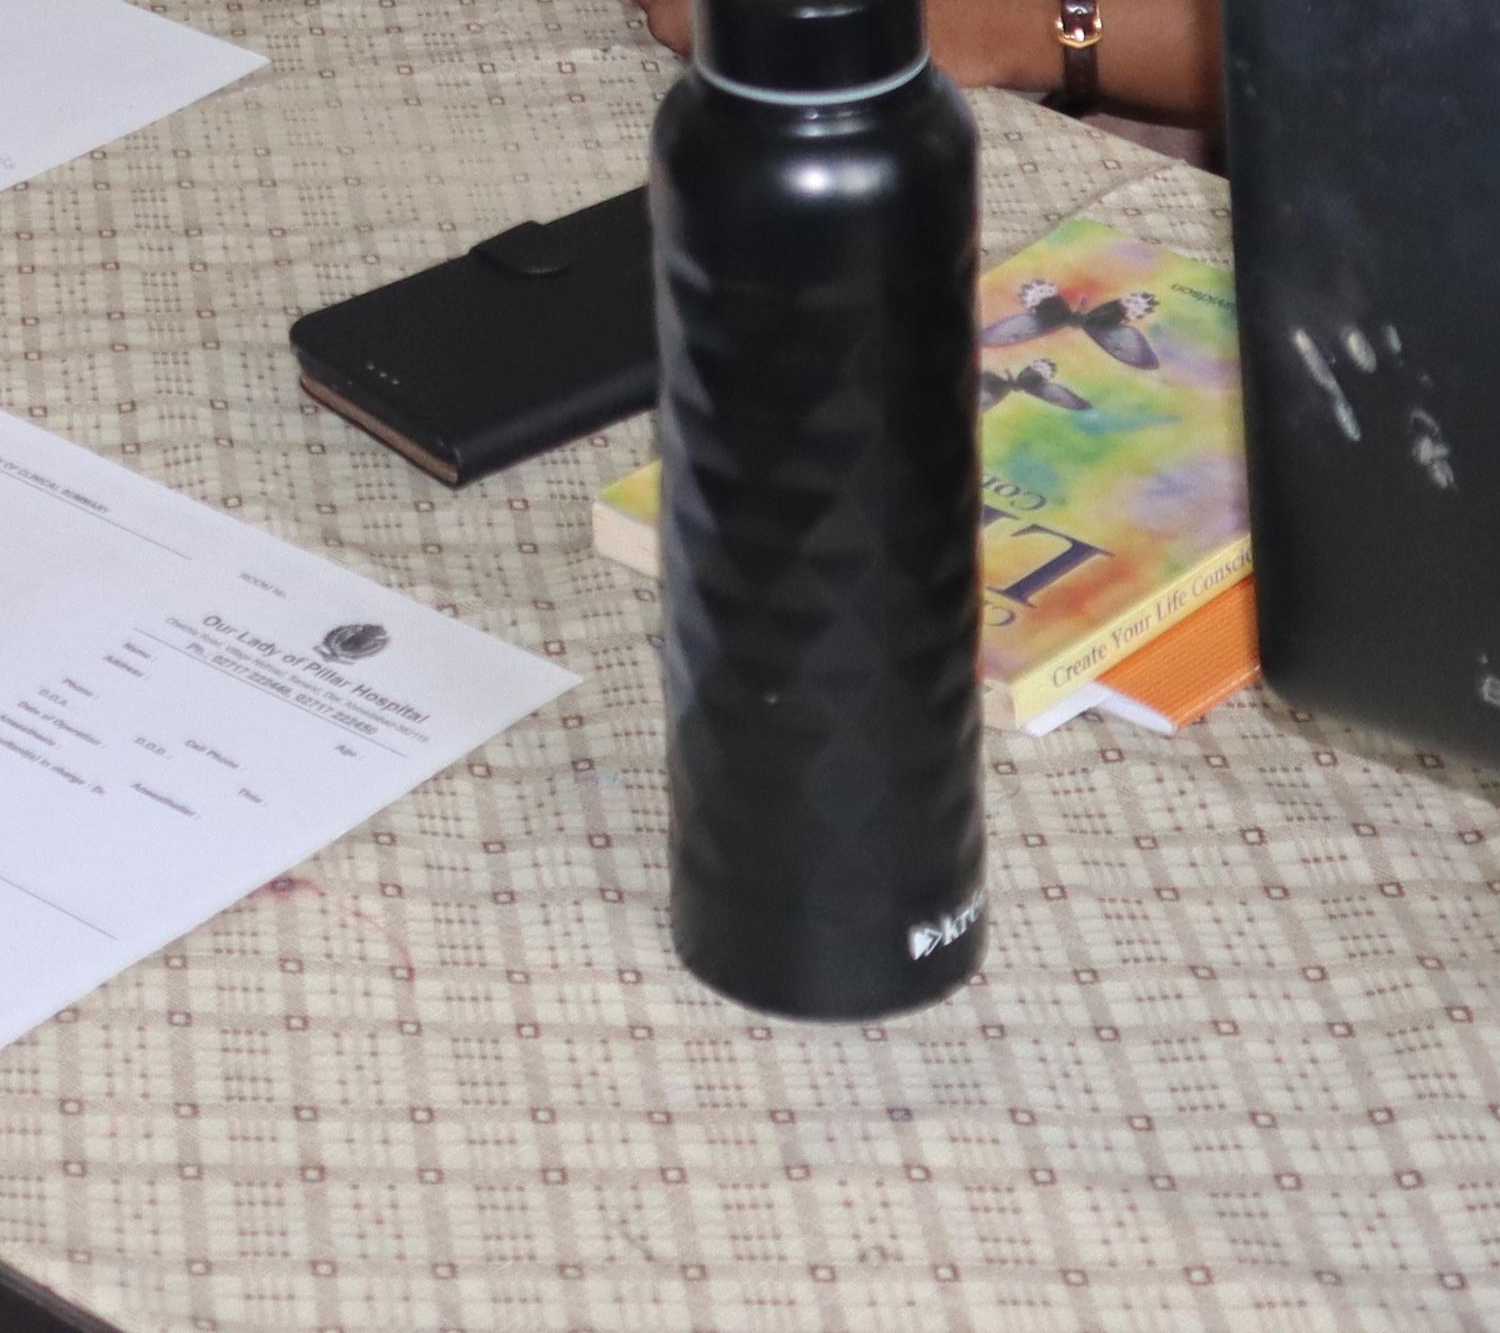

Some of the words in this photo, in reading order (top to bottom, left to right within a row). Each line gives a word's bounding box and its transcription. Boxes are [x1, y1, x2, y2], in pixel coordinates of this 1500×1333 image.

[203, 615, 238, 637] Our
[237, 631, 282, 657] Lady
[282, 654, 305, 665] of
[303, 662, 350, 688] Pillar
[351, 684, 431, 724] Hospital
[1052, 644, 1107, 689] Create
[1111, 617, 1151, 650] Your
[1155, 589, 1187, 622] Life
